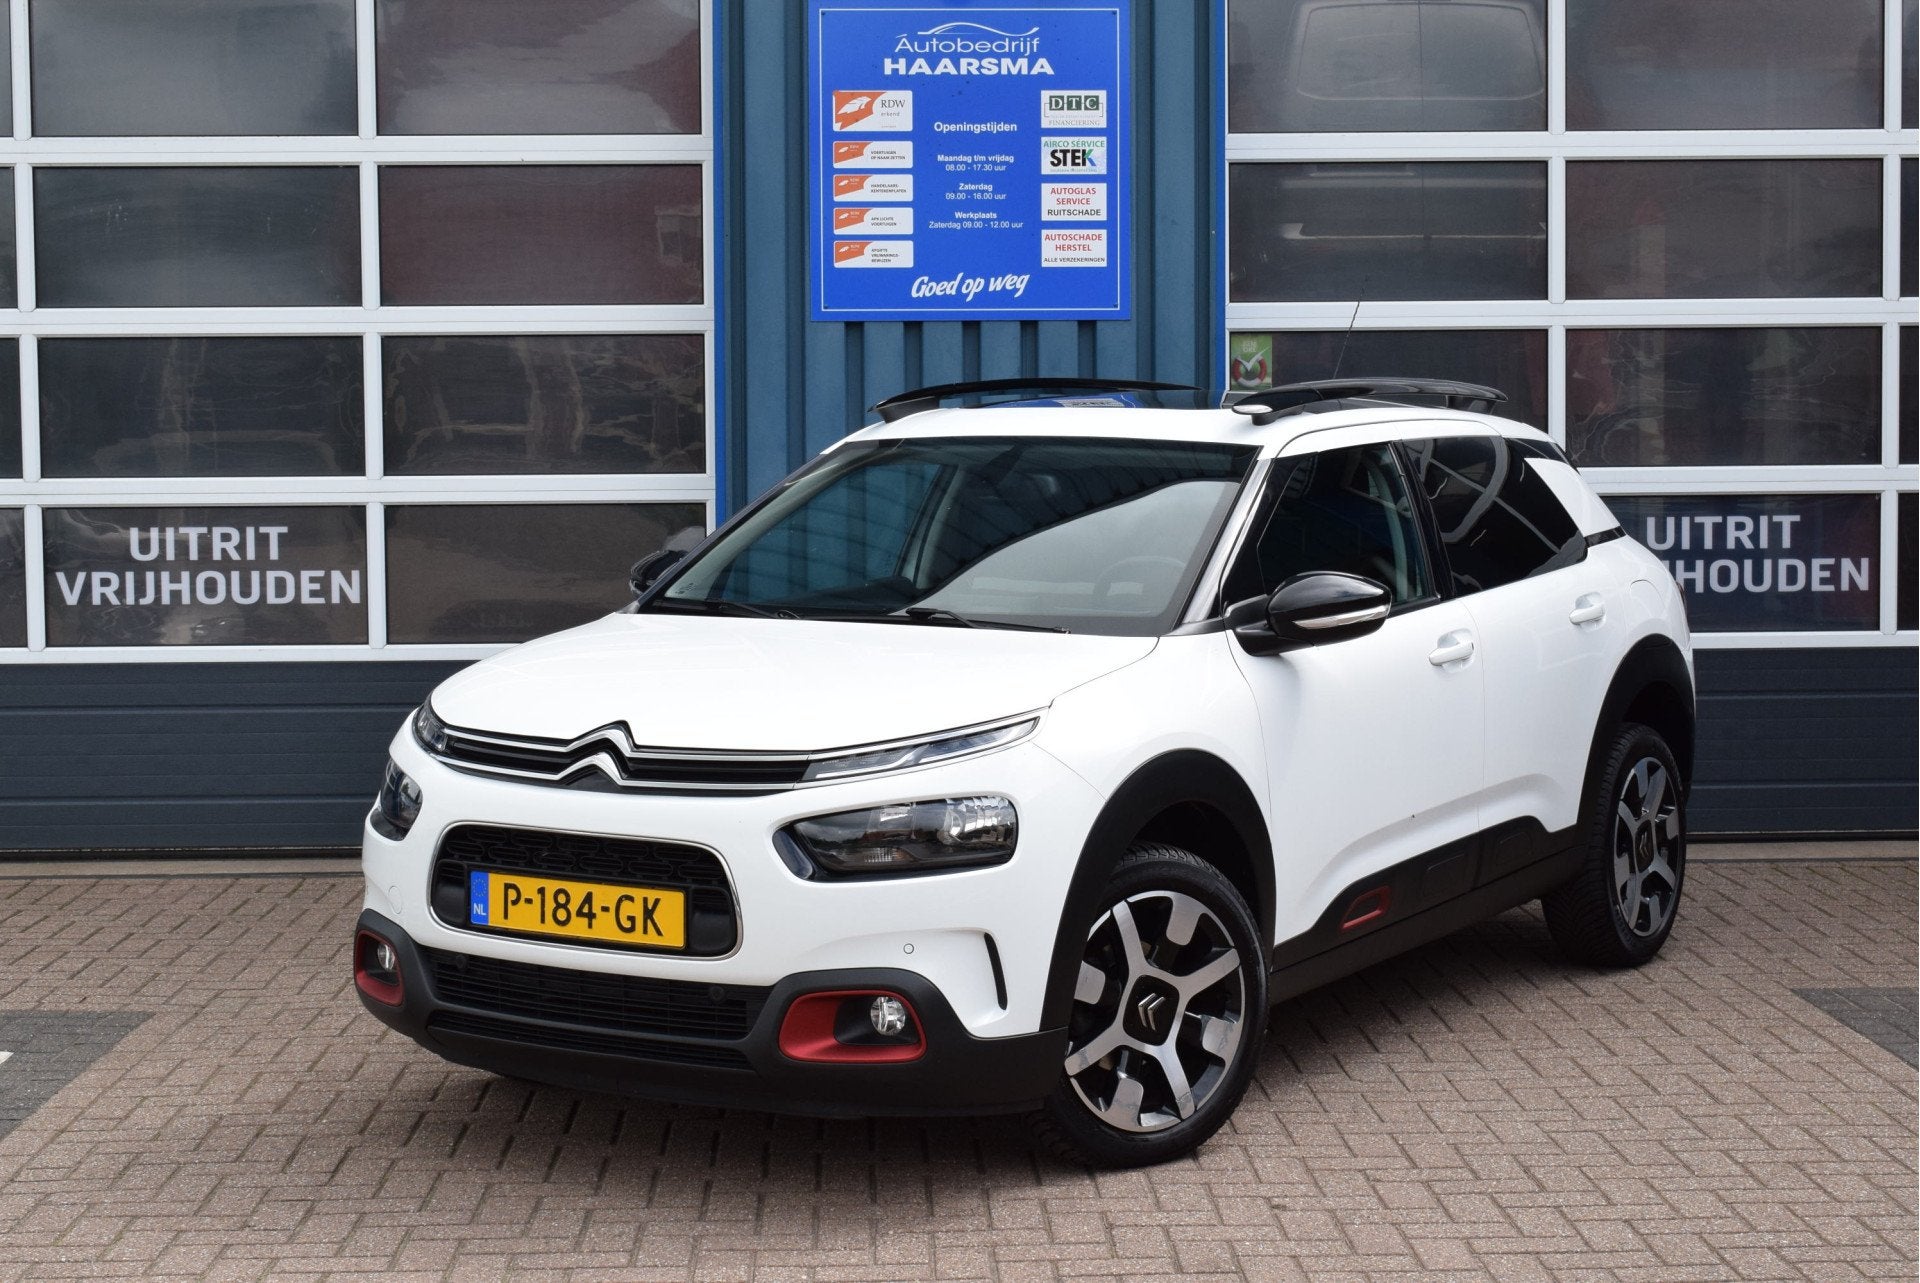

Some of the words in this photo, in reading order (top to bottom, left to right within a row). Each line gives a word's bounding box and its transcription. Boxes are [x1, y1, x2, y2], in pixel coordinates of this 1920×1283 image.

[895, 37, 1040, 56] Autobedrijf
[884, 57, 1055, 75] HAARSMA
[881, 99, 906, 108] RDW
[1050, 97, 1097, 110] DTC
[934, 121, 1018, 134] Openingstijden
[1043, 140, 1070, 148] AIRCO
[1072, 140, 1105, 148] SERVICE
[937, 154, 972, 163] Maandag
[974, 154, 986, 162] t/m
[988, 154, 1014, 163] vrijdag
[1050, 148, 1097, 167] STEK
[959, 183, 993, 192] Zaterdag
[1050, 187, 1097, 195] AUTOGLAS
[1056, 197, 1091, 205] SERVICE
[955, 211, 997, 220] Werkplaats
[929, 221, 961, 230] Zaterdag
[1044, 233, 1103, 241] AUTOSCHADE
[1055, 244, 1092, 252] HERSTEL
[911, 272, 964, 298] Goed
[961, 277, 985, 302] op
[988, 273, 1030, 298] weg
[1646, 515, 1801, 550] UITRIT
[130, 526, 288, 561] UITRIT
[55, 569, 362, 606] VRIJHOUDEN
[473, 902, 487, 916] NL
[503, 882, 664, 937] P-184-GK
